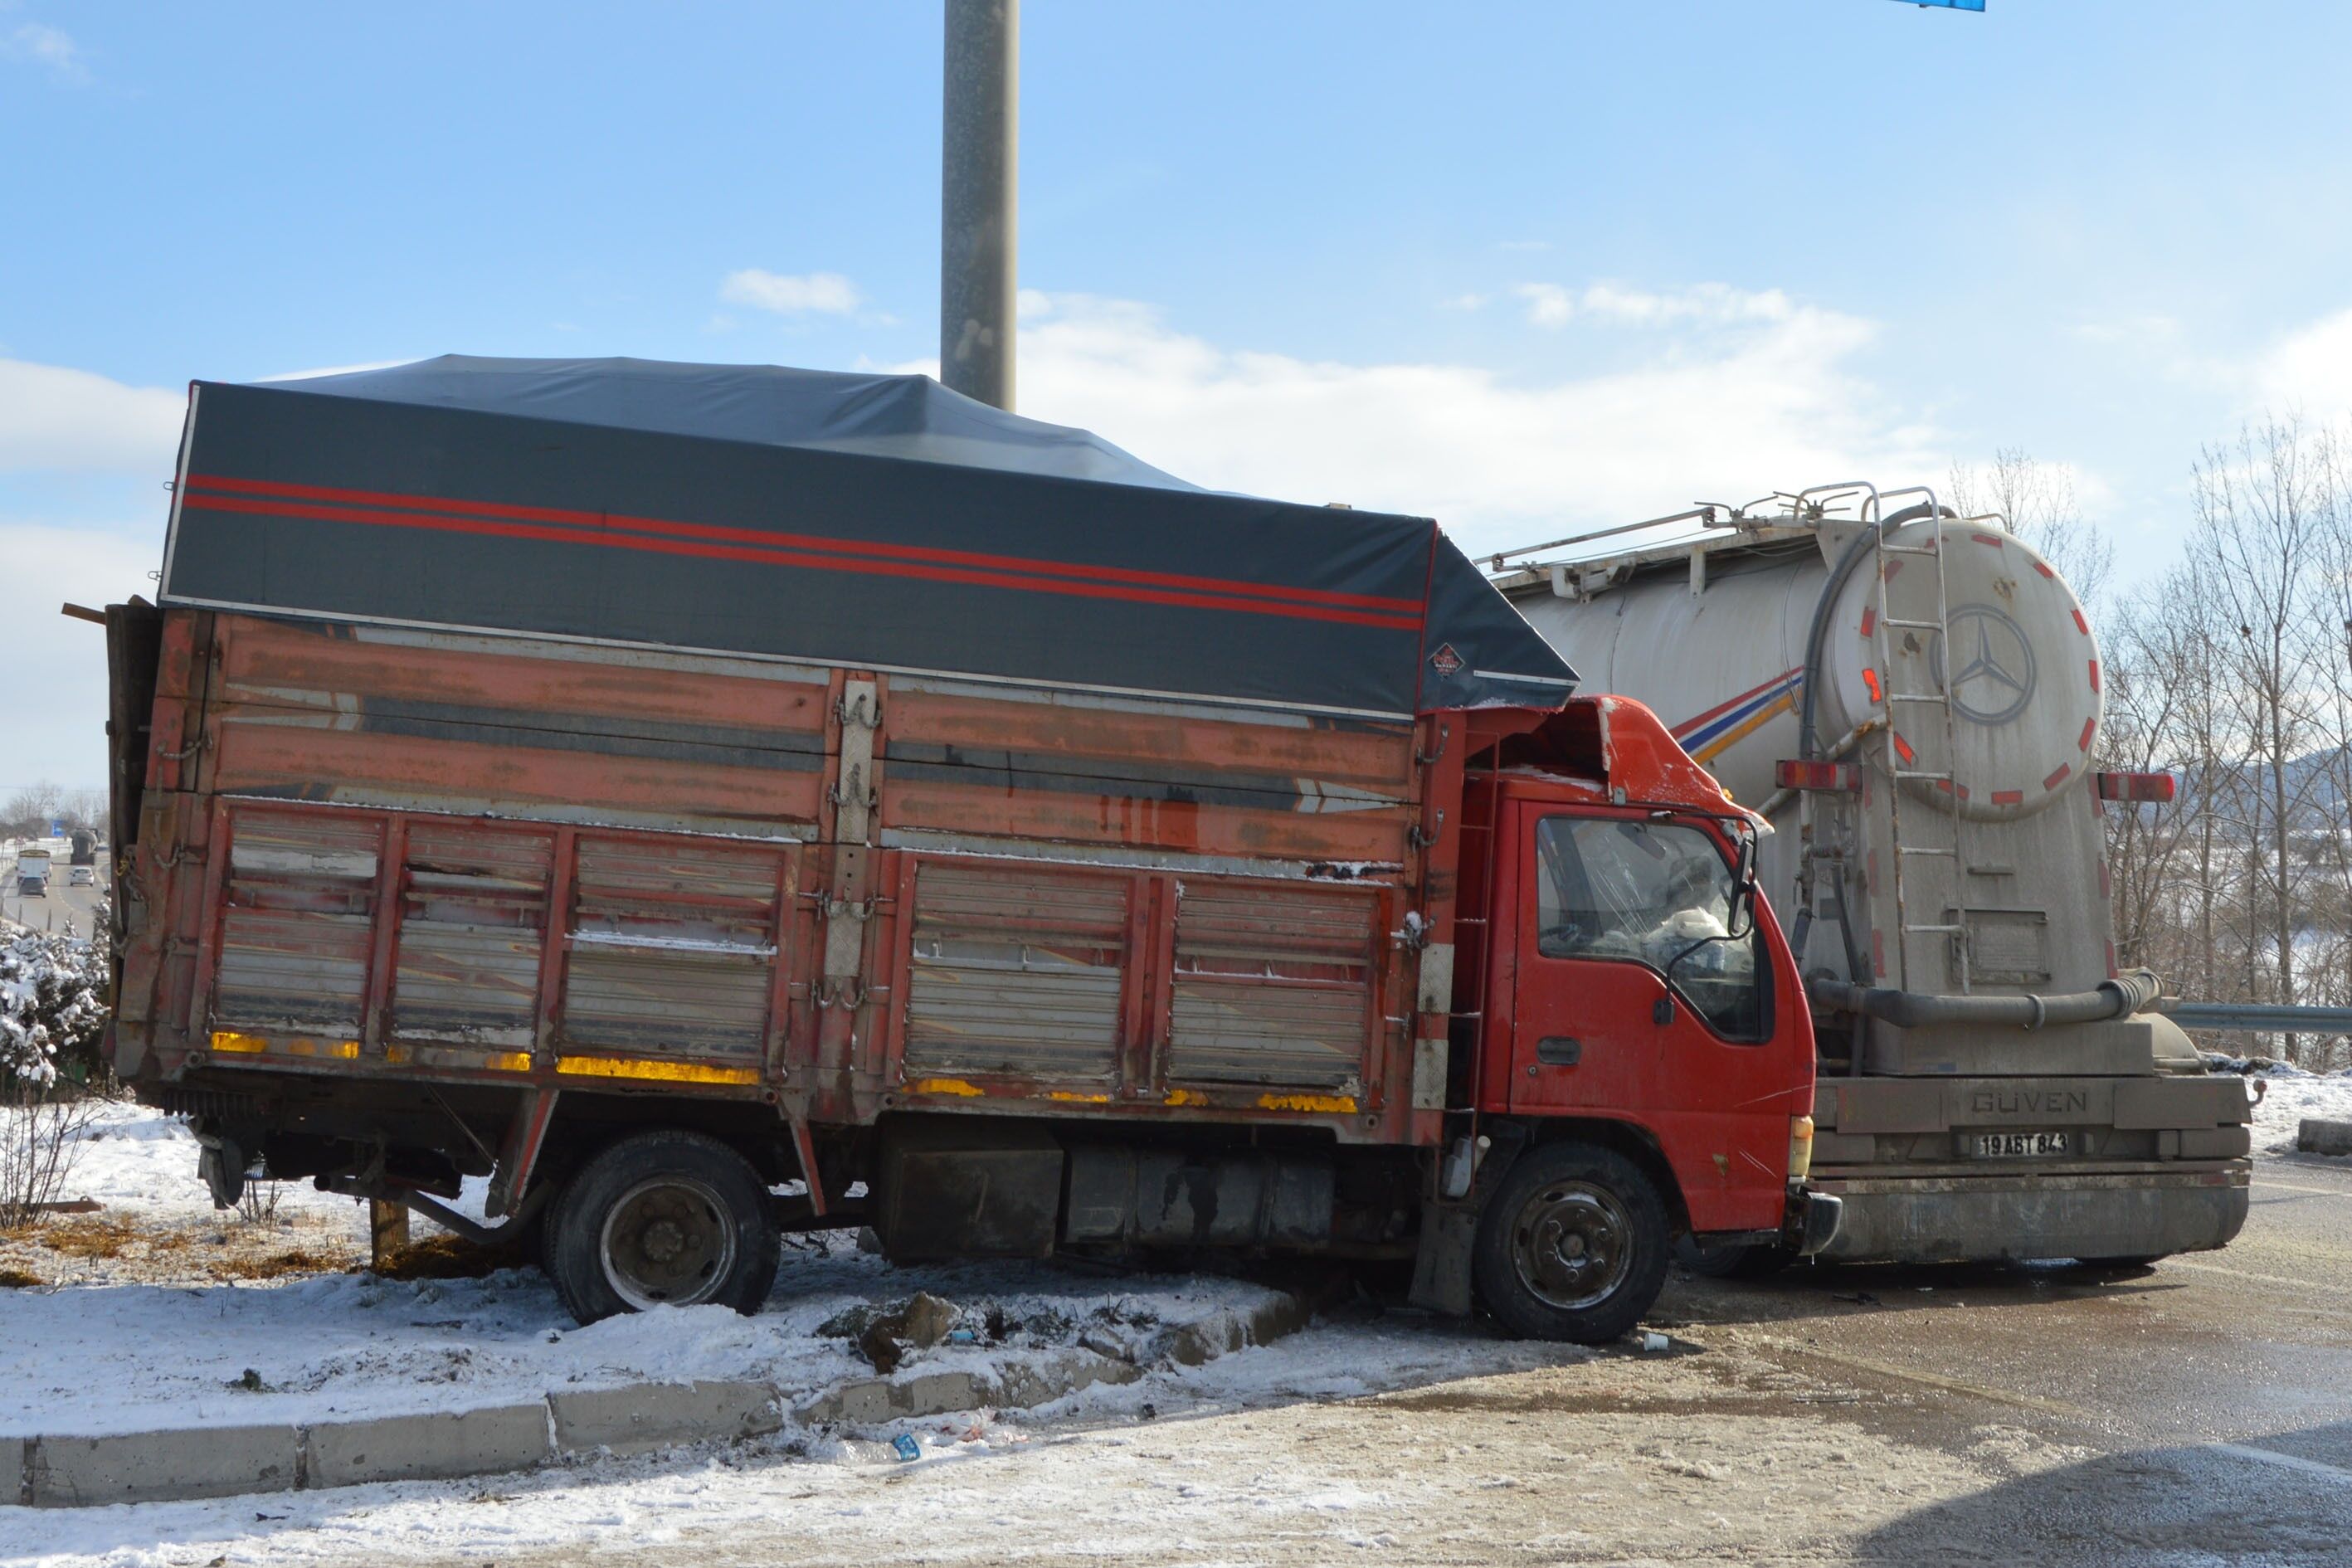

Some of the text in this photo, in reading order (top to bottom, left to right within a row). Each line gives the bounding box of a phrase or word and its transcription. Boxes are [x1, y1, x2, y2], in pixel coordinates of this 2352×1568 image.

[1983, 1134, 2067, 1156] 19 ABT 843
